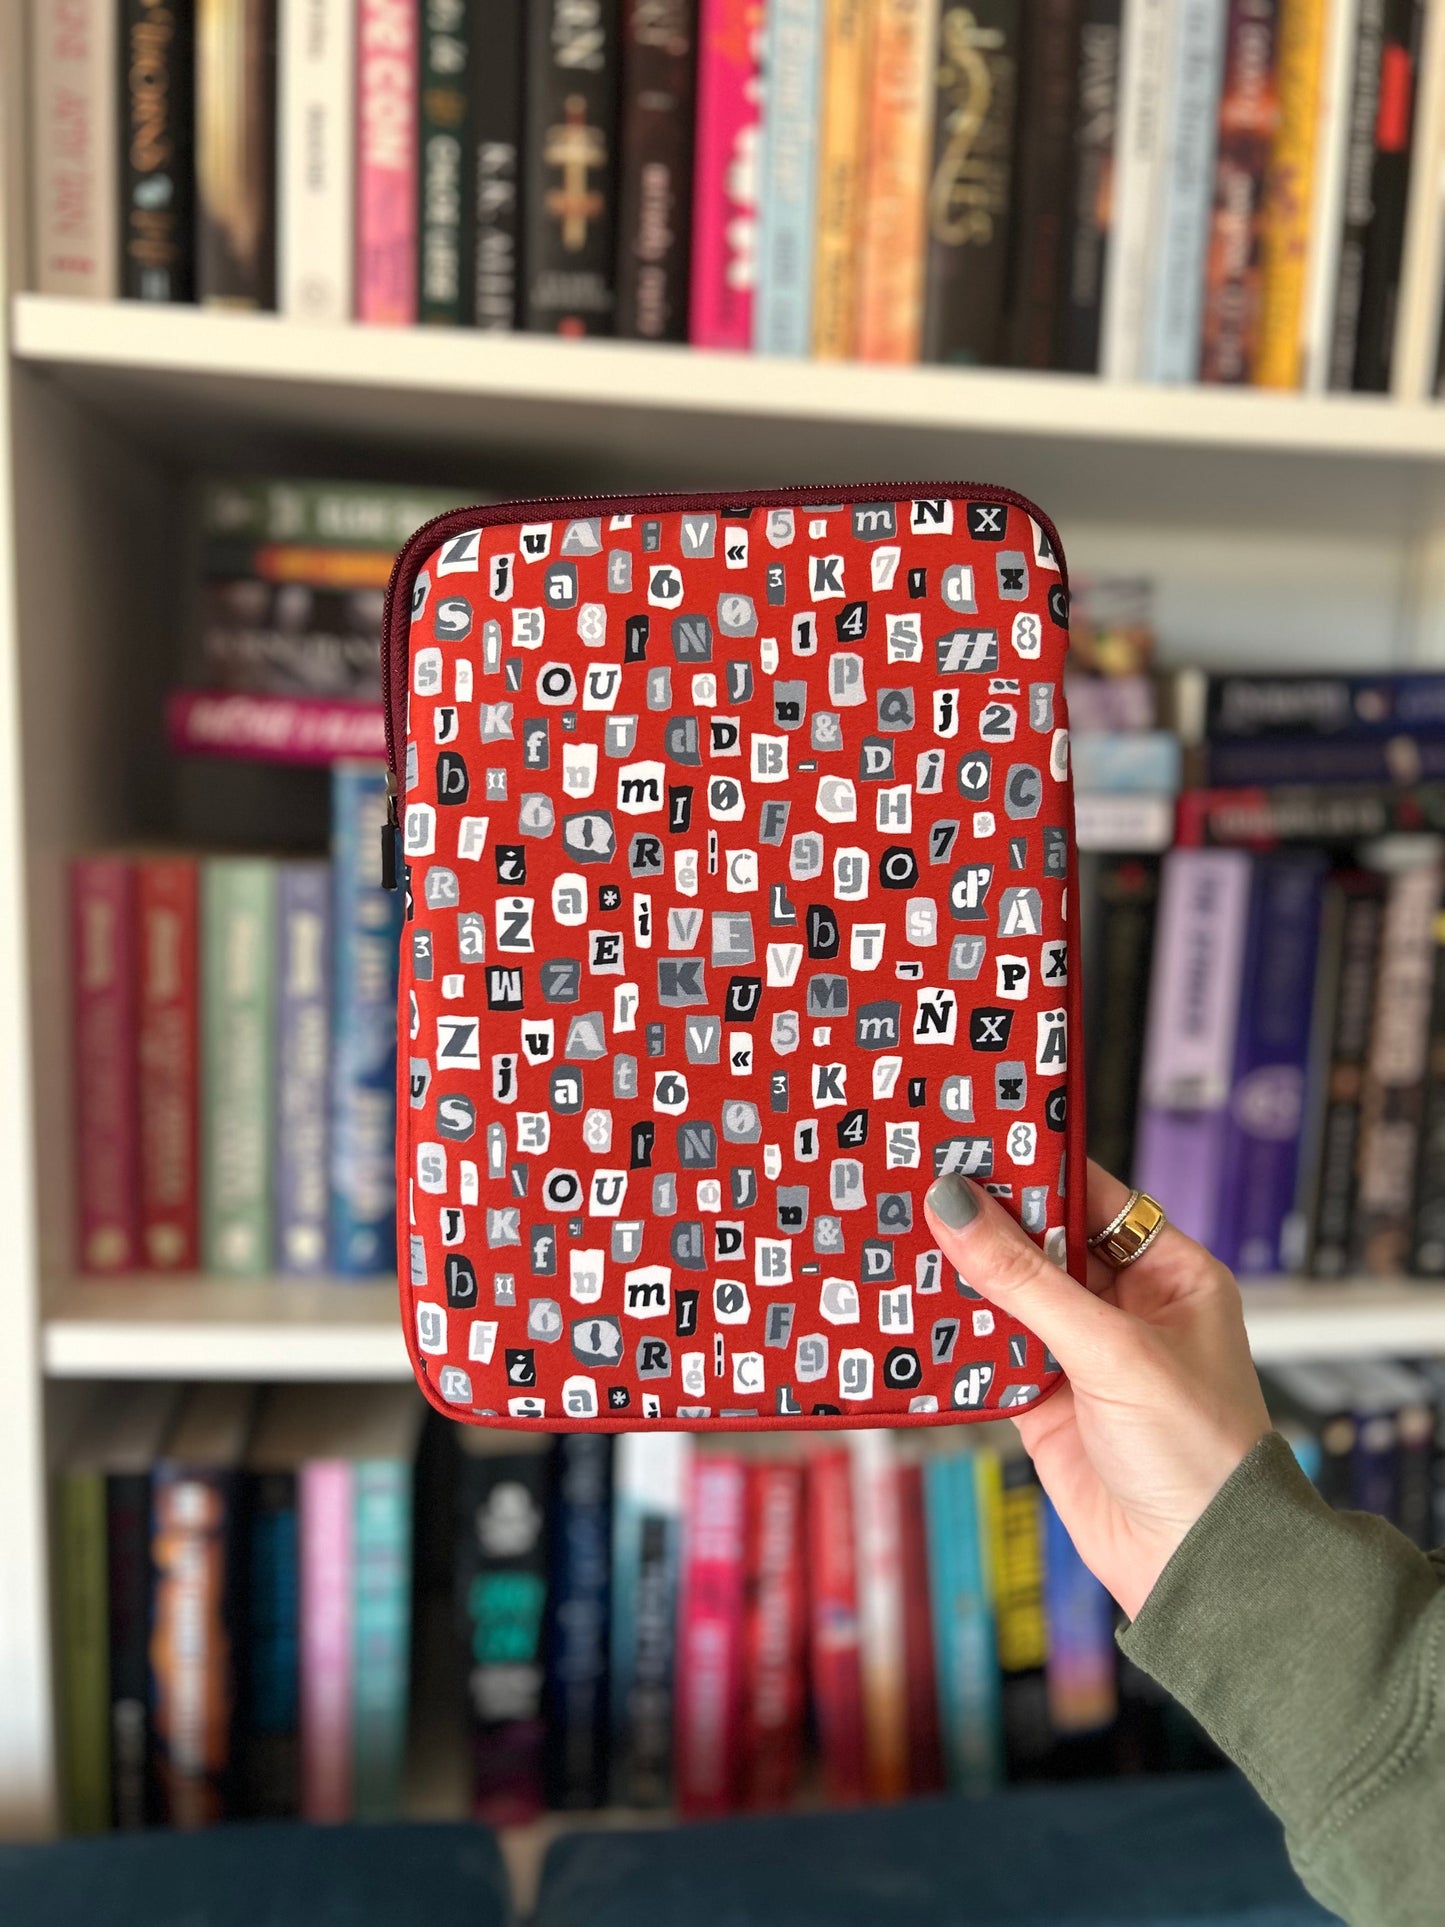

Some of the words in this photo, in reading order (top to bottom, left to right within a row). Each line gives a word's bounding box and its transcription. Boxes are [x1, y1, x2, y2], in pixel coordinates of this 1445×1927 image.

[562, 521, 599, 549] A
[771, 511, 792, 538] 5
[855, 510, 893, 531] m
[441, 531, 481, 564] Z
[523, 533, 546, 554] u
[494, 557, 509, 596] j
[610, 556, 627, 585] t
[651, 570, 681, 599] 6
[768, 568, 783, 588] 3
[813, 559, 840, 592] K
[875, 554, 897, 584] 7
[549, 575, 573, 600] a
[947, 568, 973, 602] d
[517, 613, 541, 641] 3
[581, 607, 603, 640] 8
[797, 621, 811, 649] 1
[842, 607, 863, 636] 4
[1017, 616, 1037, 650] 8
[487, 625, 498, 664] i
[632, 626, 646, 654] r
[679, 621, 707, 654] N
[589, 670, 618, 700] U
[651, 675, 668, 702] 1
[732, 663, 749, 700] J
[483, 705, 511, 734] K
[775, 700, 800, 722] n
[879, 692, 913, 725] Q
[938, 692, 953, 732] j
[982, 705, 1011, 735] 2
[1034, 686, 1049, 726] j
[437, 708, 454, 740] J
[608, 717, 634, 747] T
[671, 720, 696, 754] d
[712, 722, 738, 750] D
[527, 730, 546, 763] f
[757, 742, 783, 774] B
[863, 746, 891, 773] D
[441, 759, 465, 795] b
[566, 766, 592, 788] n
[921, 753, 940, 789] i
[621, 778, 660, 802] m
[819, 781, 855, 813] G
[1010, 768, 1036, 808] C
[521, 797, 552, 828] 6
[764, 804, 785, 837] F
[880, 793, 907, 825] H
[408, 812, 429, 848] g
[462, 821, 485, 852] F
[564, 816, 613, 854] Q
[933, 826, 955, 858] 7
[632, 838, 661, 868] R
[794, 839, 819, 871] 9
[731, 853, 752, 885] C
[838, 856, 861, 894] g
[429, 872, 456, 899] R
[557, 887, 582, 914] a
[774, 886, 796, 918] L
[812, 912, 836, 948] b
[855, 929, 881, 960] T
[414, 936, 430, 958] 3
[593, 935, 620, 966] E
[954, 942, 980, 969] U
[549, 965, 574, 996] Z
[660, 961, 702, 997] K
[810, 979, 848, 1009] M
[620, 994, 636, 1023] r
[732, 985, 759, 1012] U
[441, 1023, 477, 1058] Z
[567, 1021, 600, 1052] A
[776, 1014, 797, 1045] 5
[859, 1014, 896, 1039] m
[525, 1033, 549, 1056] u
[498, 1057, 511, 1097] j
[554, 1077, 579, 1105] a
[616, 1062, 633, 1090] t
[656, 1074, 686, 1104] 6
[773, 1076, 786, 1094] 3
[816, 1067, 842, 1100] K
[877, 1064, 898, 1092] 7
[946, 1079, 969, 1110] d
[522, 1116, 546, 1146] 3
[587, 1107, 609, 1145] 8
[800, 1127, 813, 1156] 1
[843, 1114, 863, 1142] 4
[1012, 1125, 1032, 1157] 8
[492, 1128, 502, 1168] i
[637, 1132, 652, 1160] r
[684, 1128, 711, 1160] N
[595, 1176, 623, 1206] U
[657, 1182, 673, 1209] 1
[736, 1168, 752, 1204] J
[879, 1194, 911, 1227] Q
[1028, 1190, 1041, 1226] j
[445, 1209, 460, 1242] J
[491, 1212, 518, 1240] K
[615, 1223, 640, 1253] T
[677, 1224, 702, 1257] d
[717, 1227, 742, 1255] D
[533, 1236, 553, 1268] f
[761, 1246, 787, 1278] B
[865, 1248, 891, 1276] D
[450, 1261, 474, 1297] b
[573, 1271, 597, 1294] n
[921, 1253, 938, 1289] i
[628, 1282, 666, 1307] m
[823, 1283, 857, 1316] G
[881, 1293, 908, 1326] H
[421, 1310, 440, 1344] g
[531, 1301, 561, 1333] 6
[769, 1306, 790, 1340] F
[474, 1325, 493, 1355] F
[573, 1319, 621, 1358] Q
[935, 1325, 956, 1357] 7
[641, 1341, 668, 1370] R
[737, 1355, 757, 1387] C
[799, 1340, 824, 1373] 9
[444, 1371, 467, 1397] R
[843, 1357, 868, 1393] g
[568, 1388, 592, 1413] a
[781, 1387, 801, 1414] L
